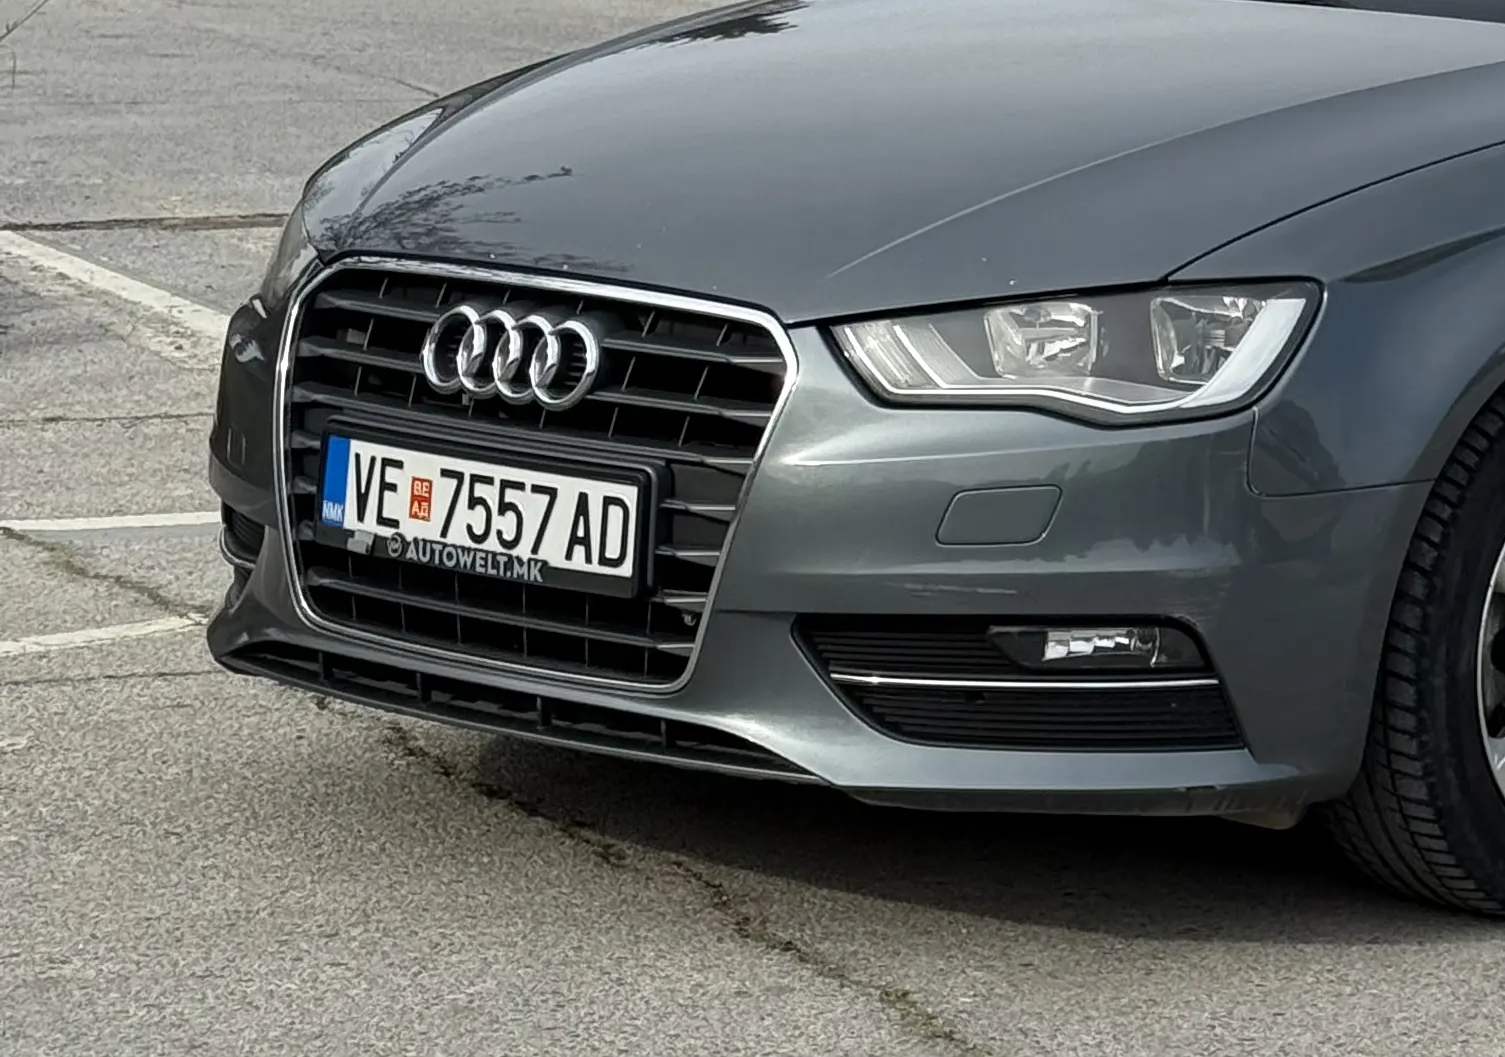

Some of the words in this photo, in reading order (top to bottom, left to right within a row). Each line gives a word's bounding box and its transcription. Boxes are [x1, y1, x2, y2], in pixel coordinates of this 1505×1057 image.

[322, 499, 344, 522] NMK
[354, 452, 404, 529] VE
[439, 468, 558, 555] 7557
[565, 491, 630, 569] AD
[405, 540, 543, 583] AUTOWELT.MK
